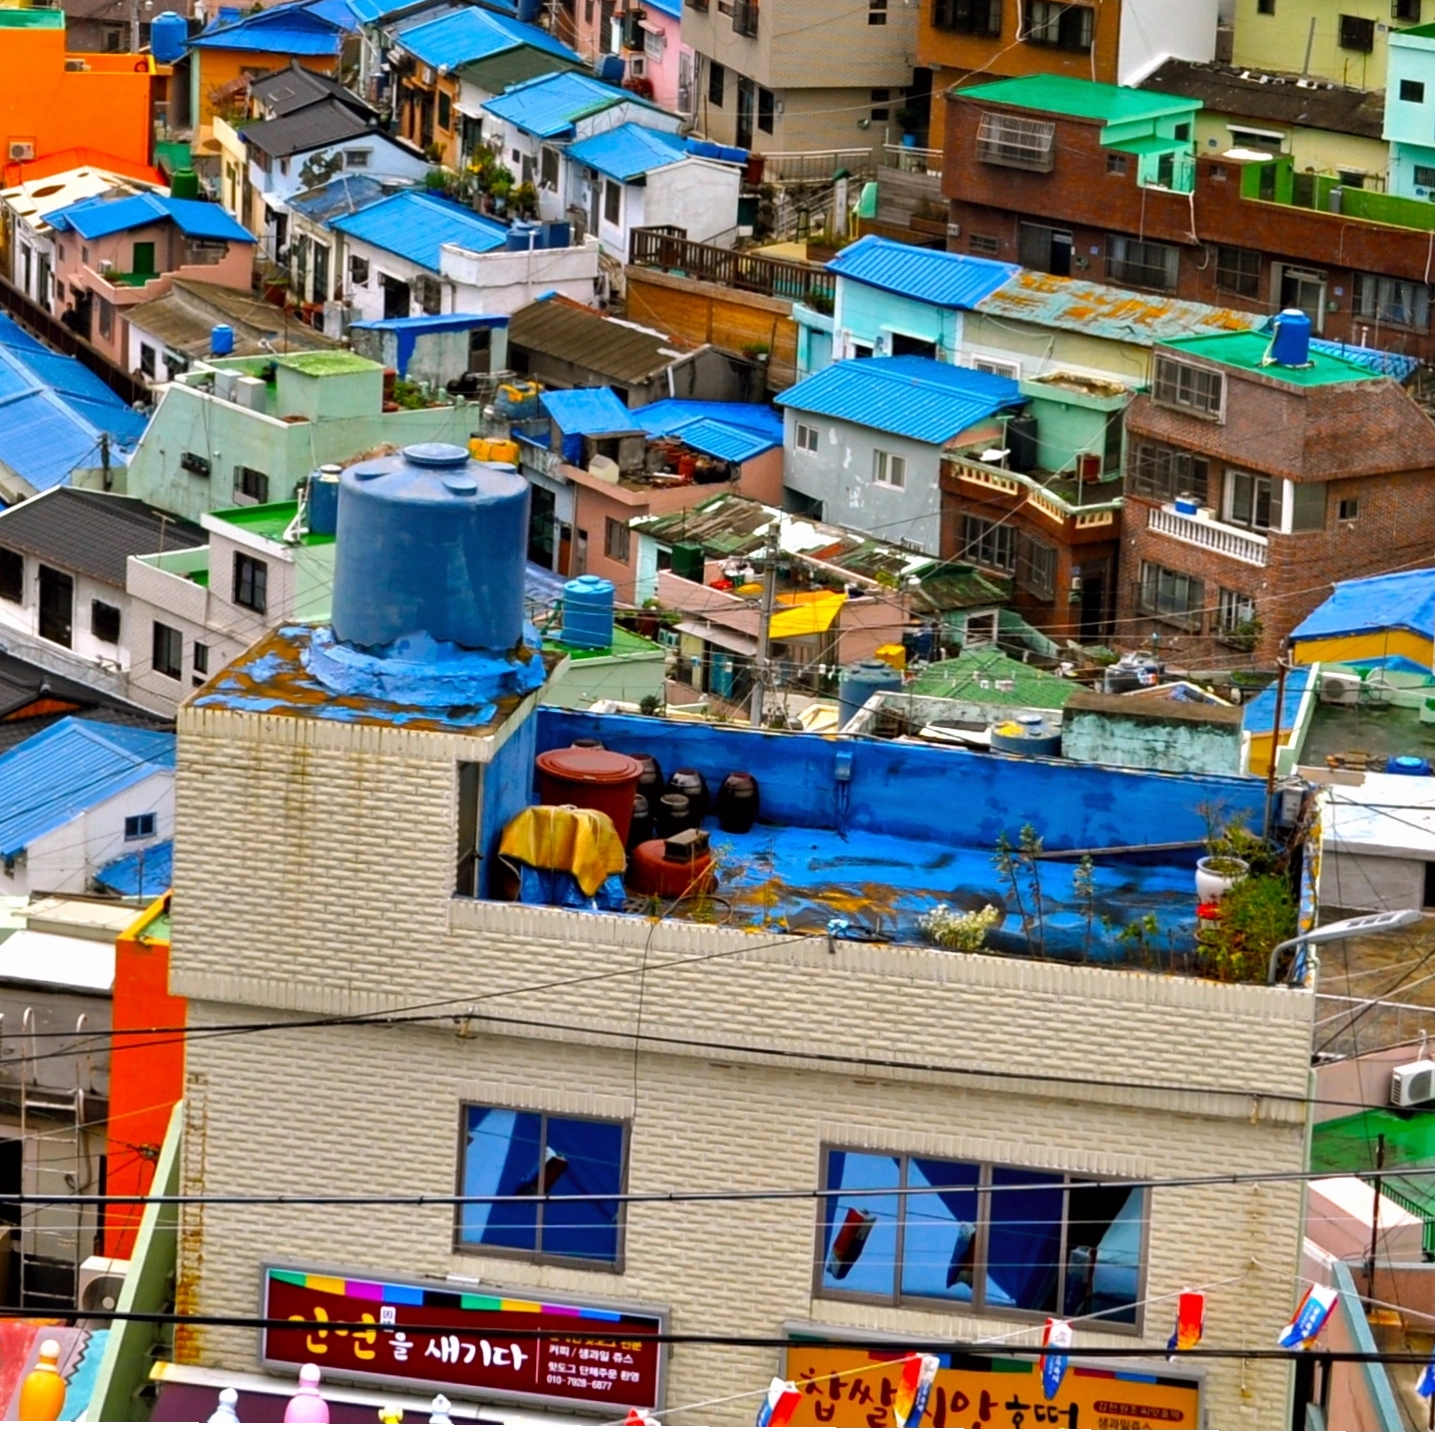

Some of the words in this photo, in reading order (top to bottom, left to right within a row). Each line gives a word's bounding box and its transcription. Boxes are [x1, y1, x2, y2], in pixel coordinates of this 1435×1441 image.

[425, 1335, 529, 1371] 새기다
[549, 1344, 570, 1357] 커피
[578, 1348, 610, 1362] 생과일
[548, 1361, 576, 1374] 핫도그
[579, 1365, 618, 1379] 단체주문
